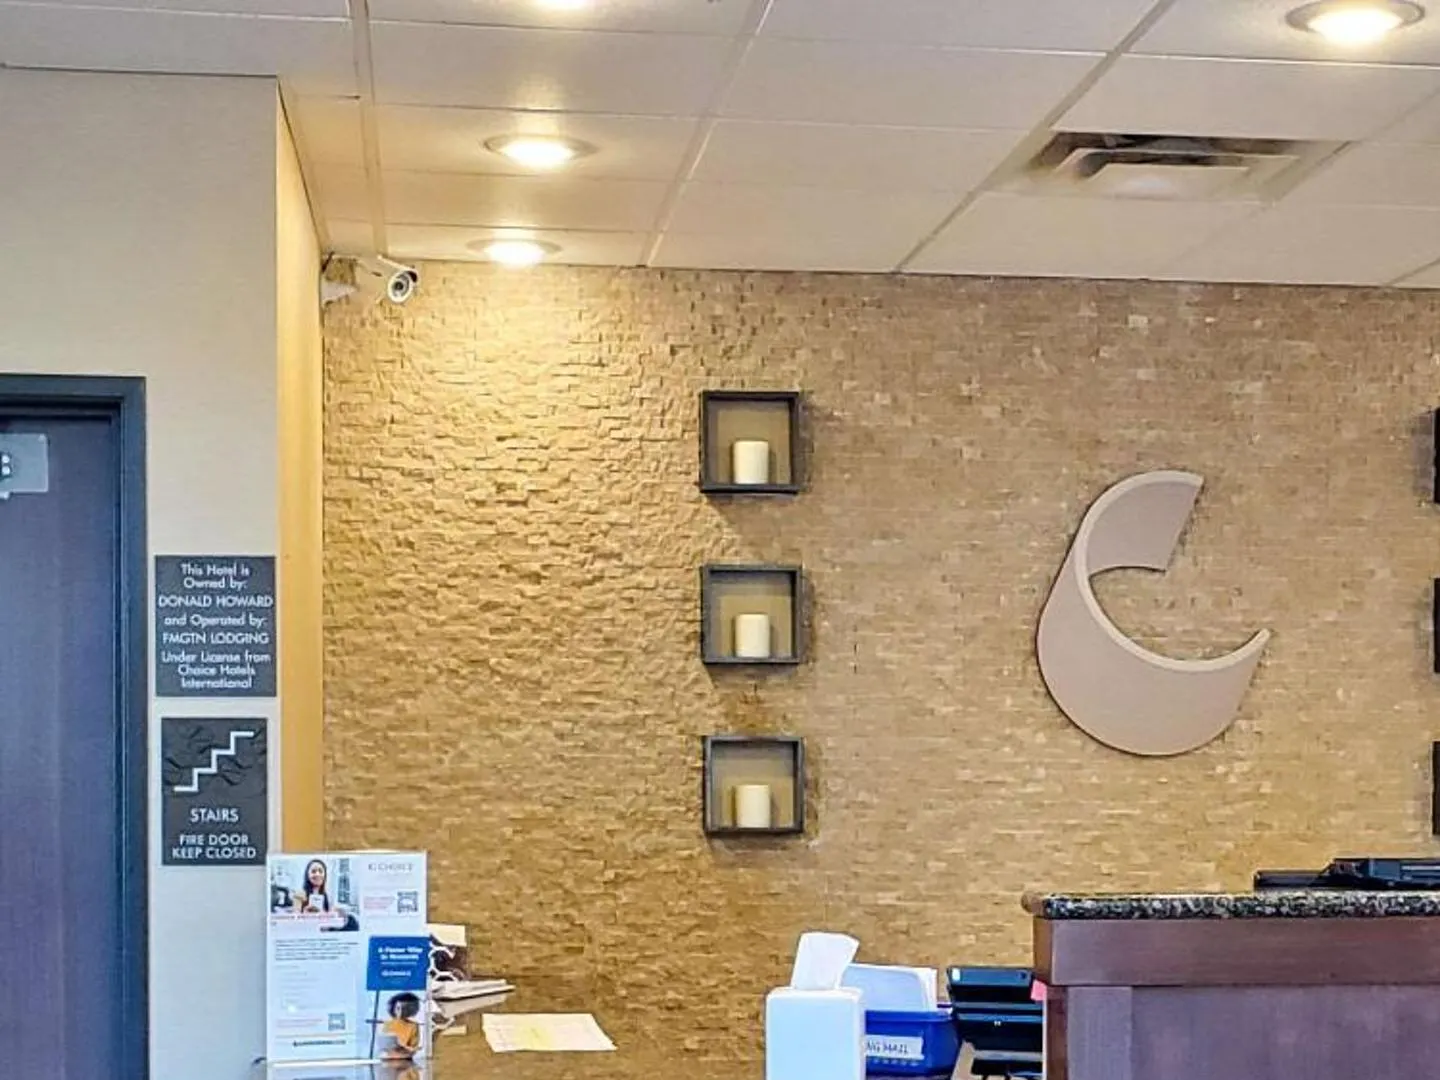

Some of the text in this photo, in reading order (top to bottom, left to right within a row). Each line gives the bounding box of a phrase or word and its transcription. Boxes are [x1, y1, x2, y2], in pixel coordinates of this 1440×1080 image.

[181, 562, 250, 576] This Hotel is
[183, 577, 225, 589] Owned
[158, 594, 273, 608] DONALD HOWARD
[164, 613, 187, 626] and
[190, 613, 245, 628] Operated
[211, 632, 270, 645] LODGING
[161, 649, 271, 663] Under License from
[178, 663, 256, 677] Choice Hotels
[181, 677, 252, 689] International
[190, 808, 239, 822] STAIRS
[179, 834, 249, 846] FIRE DOOR
[172, 848, 256, 859] KEEP CLOSED
